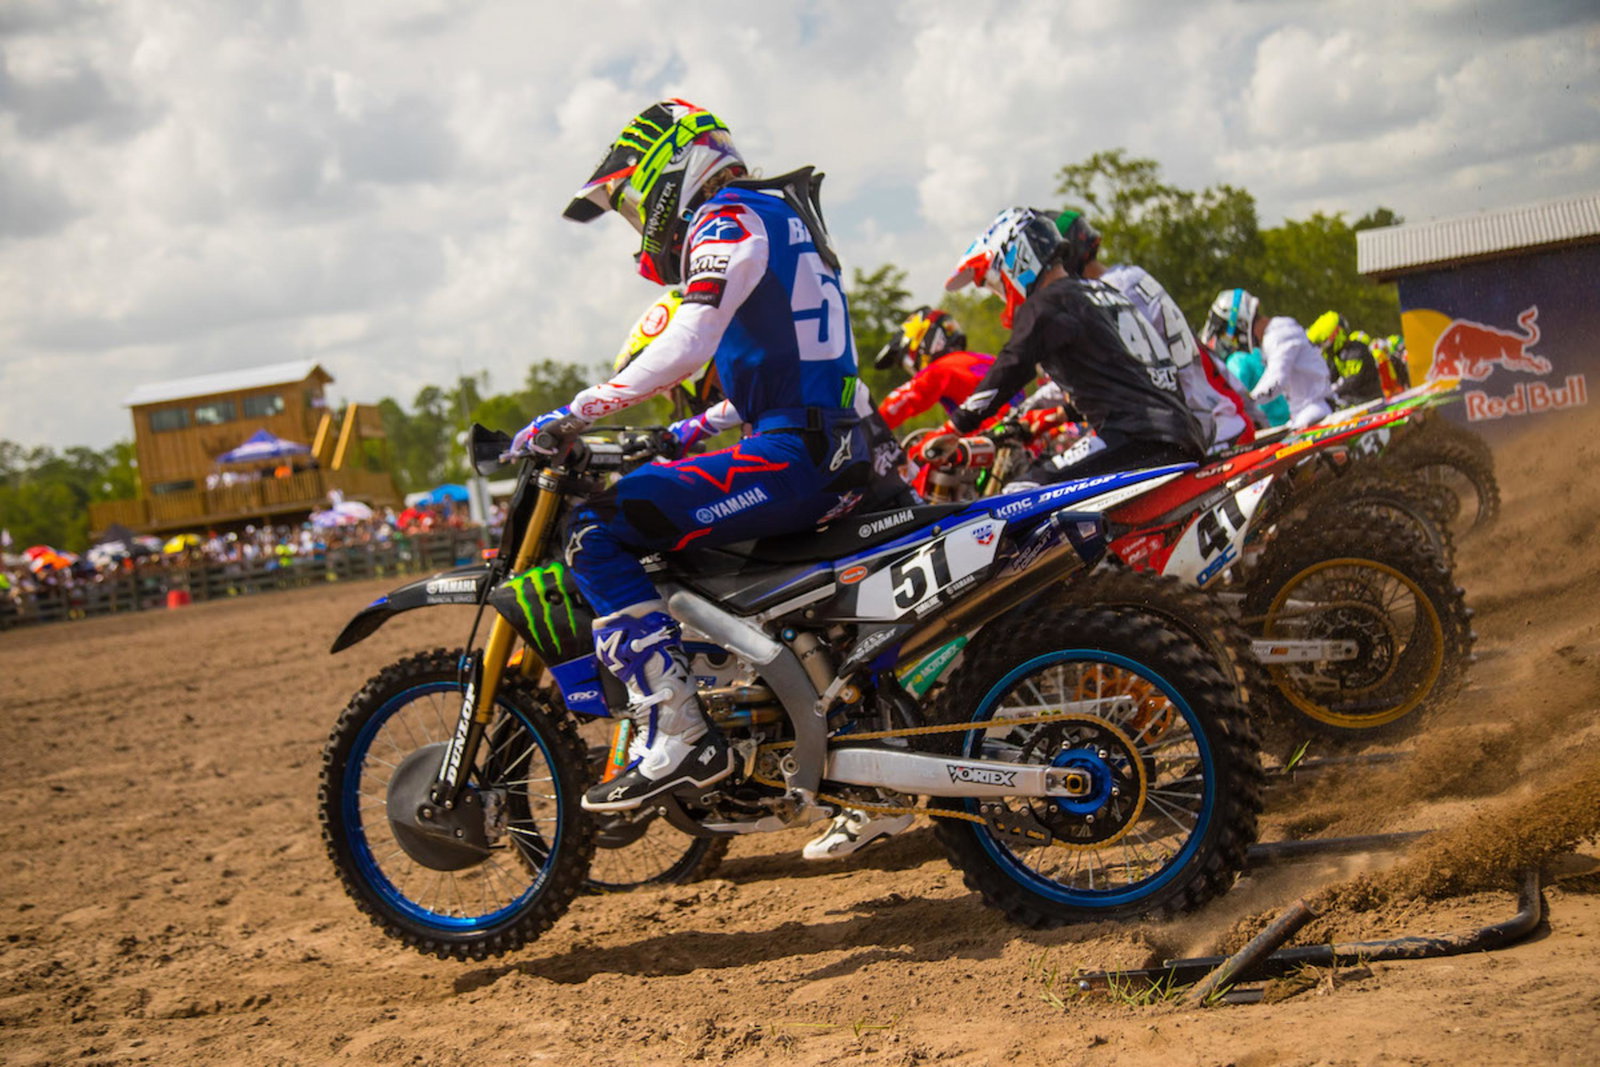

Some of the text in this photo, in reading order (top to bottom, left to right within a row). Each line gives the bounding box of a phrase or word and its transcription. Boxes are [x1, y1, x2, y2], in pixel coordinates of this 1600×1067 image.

[646, 181, 676, 237] MONSTER
[1464, 374, 1588, 421] Red Bull
[710, 487, 768, 519] YAMAHA
[996, 497, 1032, 517] KMC
[1038, 475, 1117, 503] DUNLOP
[871, 510, 915, 533] YAMAHA
[1197, 496, 1247, 561] 41
[439, 579, 477, 593] YAMAHA
[890, 537, 952, 609] 51
[920, 645, 958, 676] MOTOREX
[448, 683, 475, 786] DUNLOP
[947, 765, 1017, 787] VORTEX
